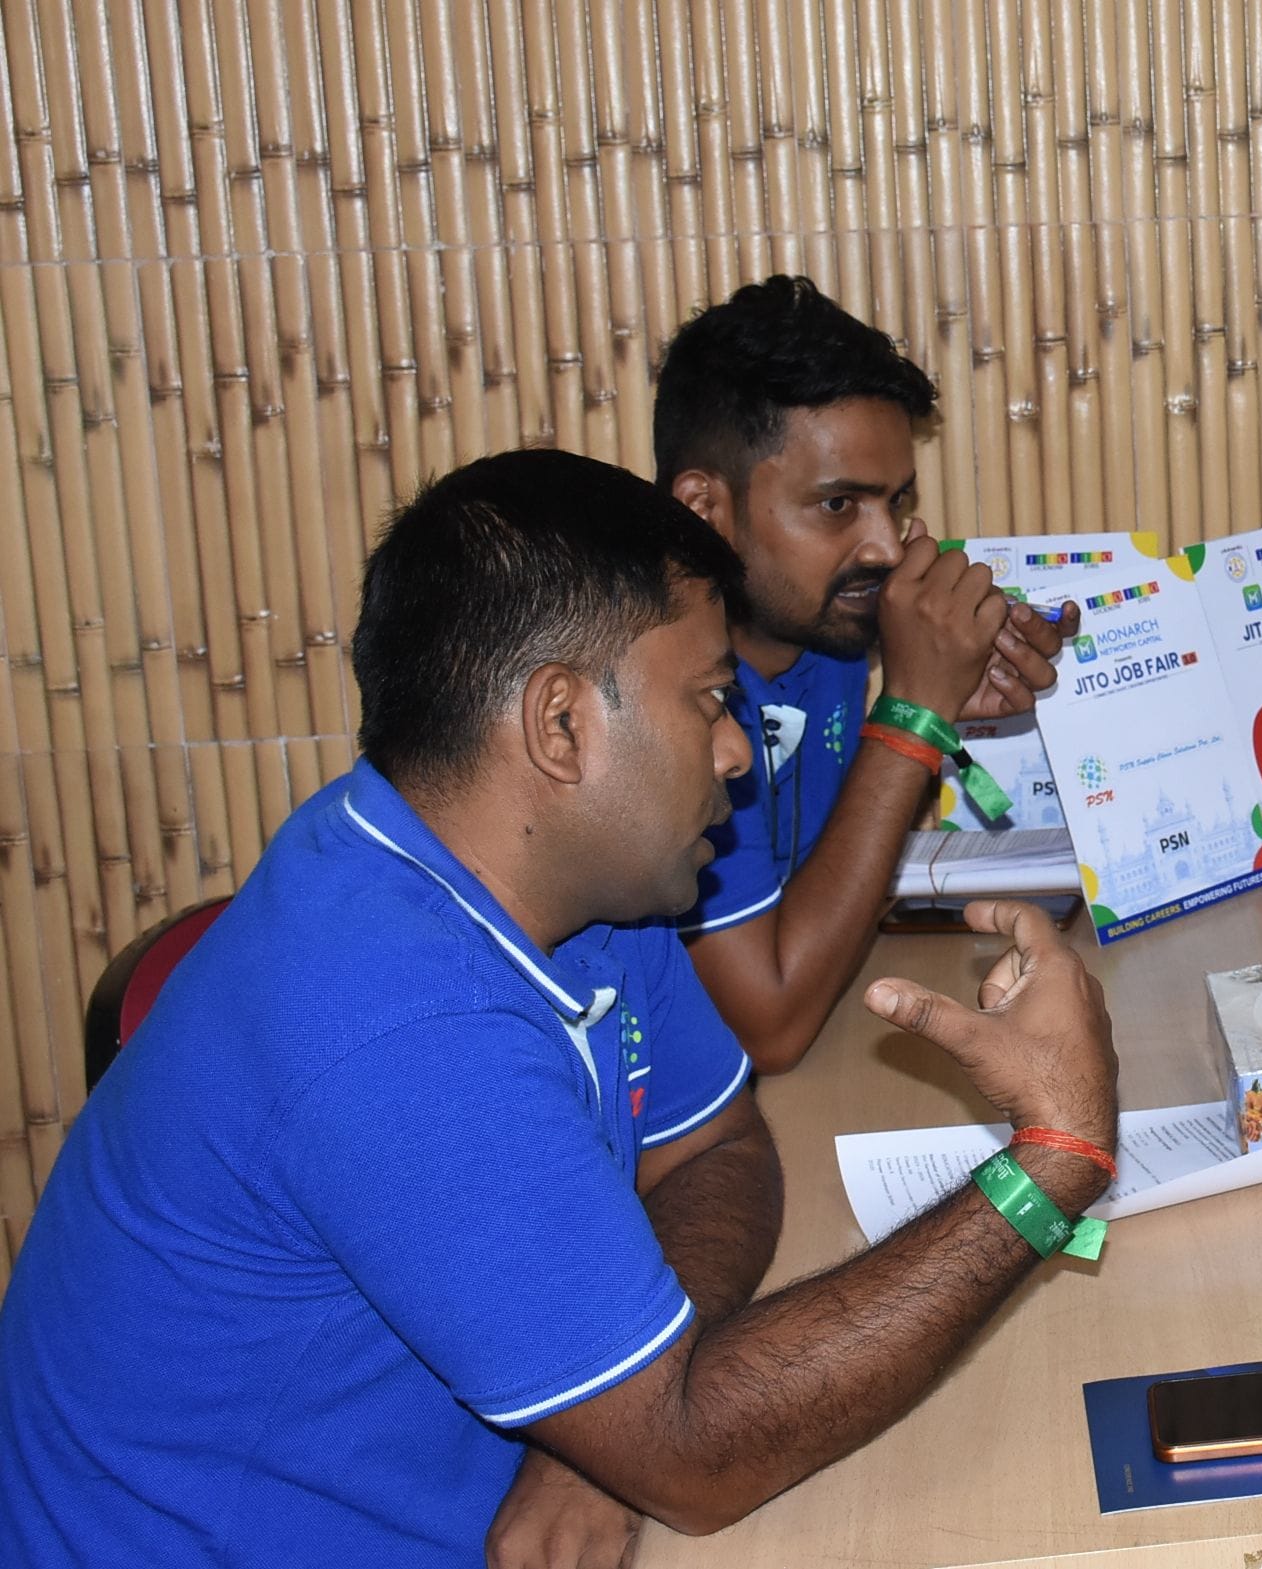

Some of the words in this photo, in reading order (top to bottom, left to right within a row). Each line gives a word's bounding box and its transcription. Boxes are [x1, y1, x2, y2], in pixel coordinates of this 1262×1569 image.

[1096, 618, 1160, 645] MONARCH
[1099, 641, 1137, 656] NETWORTH
[1138, 635, 1163, 647] CAPITAL
[1074, 672, 1109, 696] JITO
[1113, 662, 1144, 685] JOB
[1145, 652, 1180, 676] FAIR
[1032, 781, 1055, 796] PS
[1086, 789, 1115, 808] PSN
[1159, 830, 1190, 854] PSN
[1107, 917, 1145, 938] BUILDING
[1183, 885, 1233, 910] EMPOWERING
